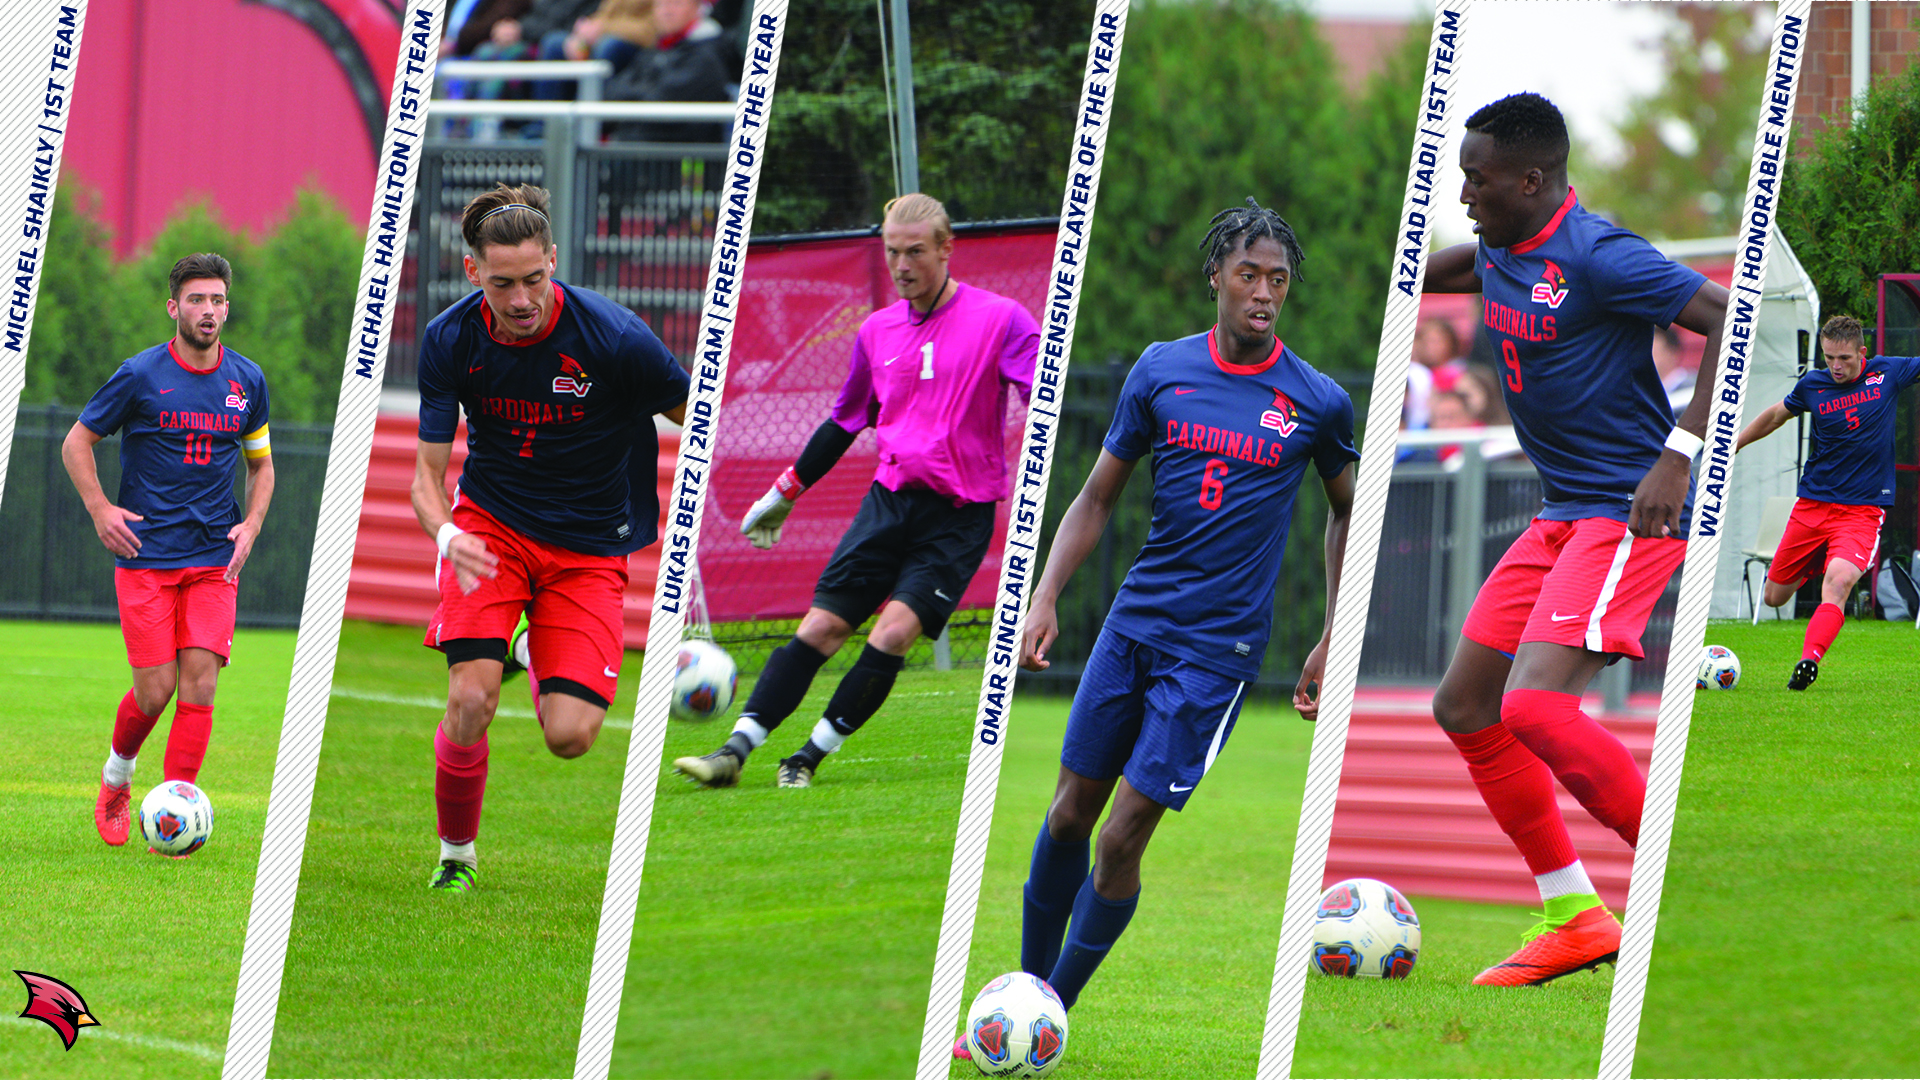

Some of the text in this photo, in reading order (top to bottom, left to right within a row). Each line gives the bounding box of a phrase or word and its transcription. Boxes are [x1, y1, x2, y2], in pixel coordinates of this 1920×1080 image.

[1531, 282, 1570, 309] SV
[1482, 294, 1558, 341] ARDINALS
[919, 341, 935, 380] 1
[1501, 338, 1523, 394] 9
[552, 376, 592, 398] SV
[1818, 387, 1882, 415] CARDINALS
[225, 394, 249, 412] SV
[1844, 406, 1861, 431] 5
[159, 410, 241, 432] CARDINALS
[1259, 409, 1300, 439] SV
[182, 432, 213, 466] 10
[511, 426, 537, 458] 7
[1166, 419, 1284, 468] CARDINALS
[1198, 458, 1229, 511] 6
